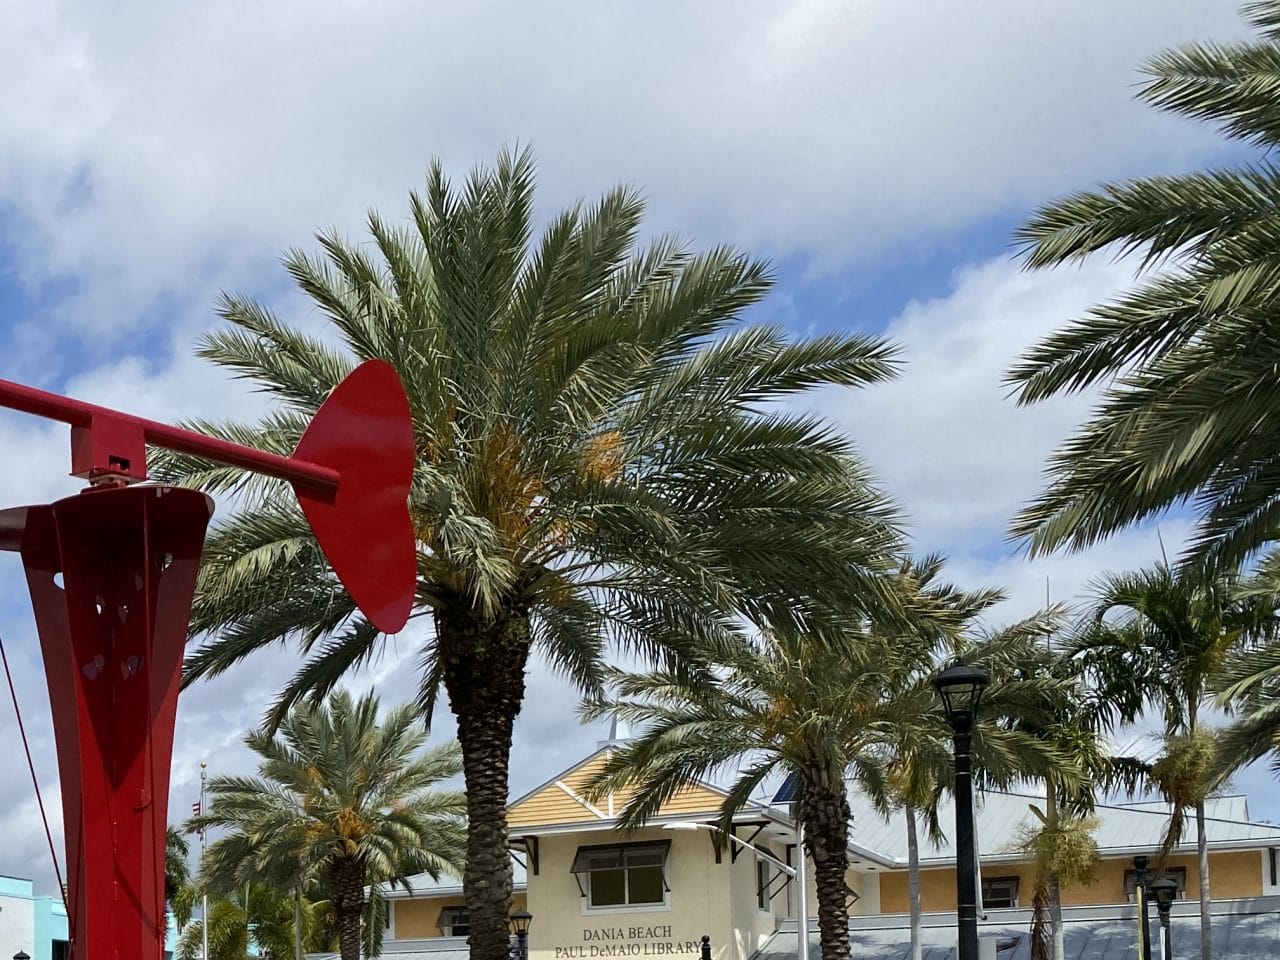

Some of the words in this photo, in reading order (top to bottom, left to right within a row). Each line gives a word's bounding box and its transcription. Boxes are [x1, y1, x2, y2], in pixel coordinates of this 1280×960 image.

[583, 927, 624, 941] DANIA
[628, 925, 672, 939] BEACH
[555, 946, 587, 959] PAUL
[590, 943, 641, 957] DeMAIO
[644, 941, 702, 955] LIBRARY
